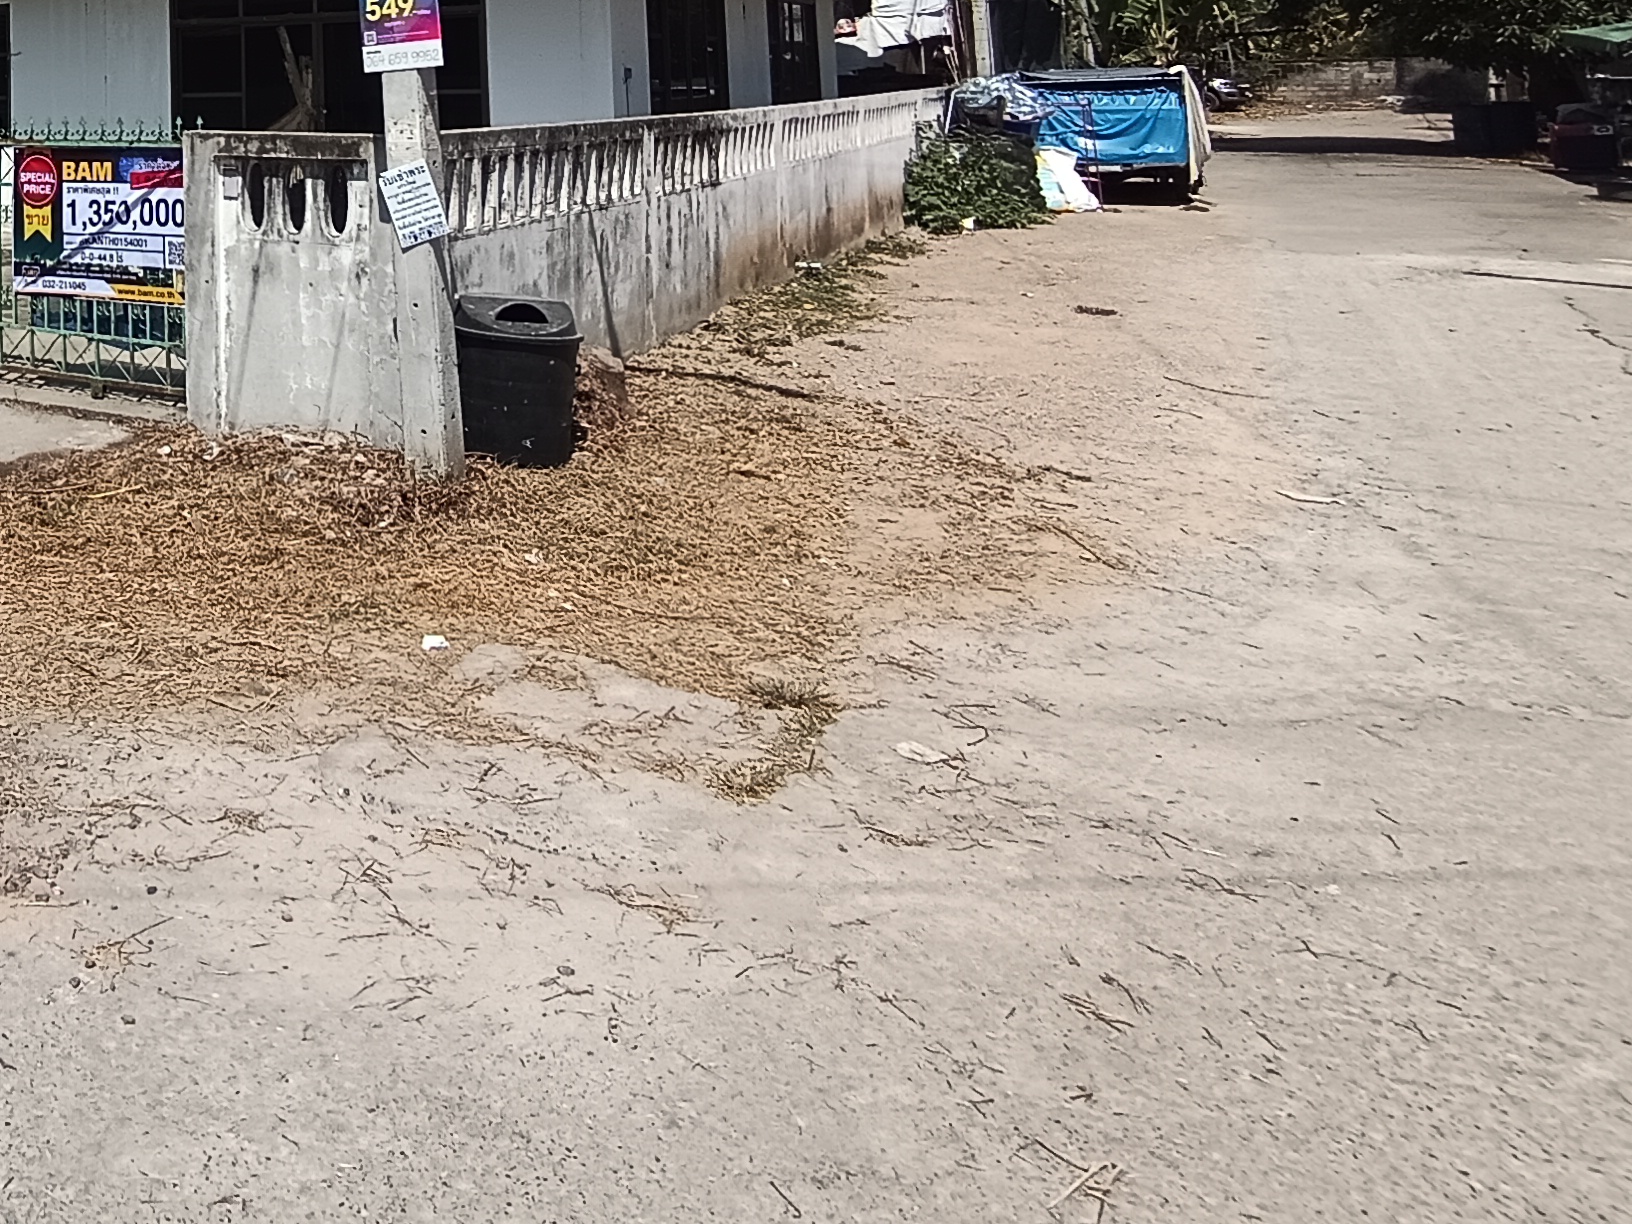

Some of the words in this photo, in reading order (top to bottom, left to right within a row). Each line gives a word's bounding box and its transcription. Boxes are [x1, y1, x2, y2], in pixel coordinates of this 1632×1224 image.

[388, 51, 408, 66] 659
[411, 48, 440, 63] 9952
[20, 172, 55, 183] SPECIAL
[62, 161, 112, 181] BAM
[23, 184, 52, 194] PRICE
[26, 213, 49, 226] ขาย
[66, 197, 184, 231] 1,350,000
[117, 287, 176, 299] www.bam.co.th
